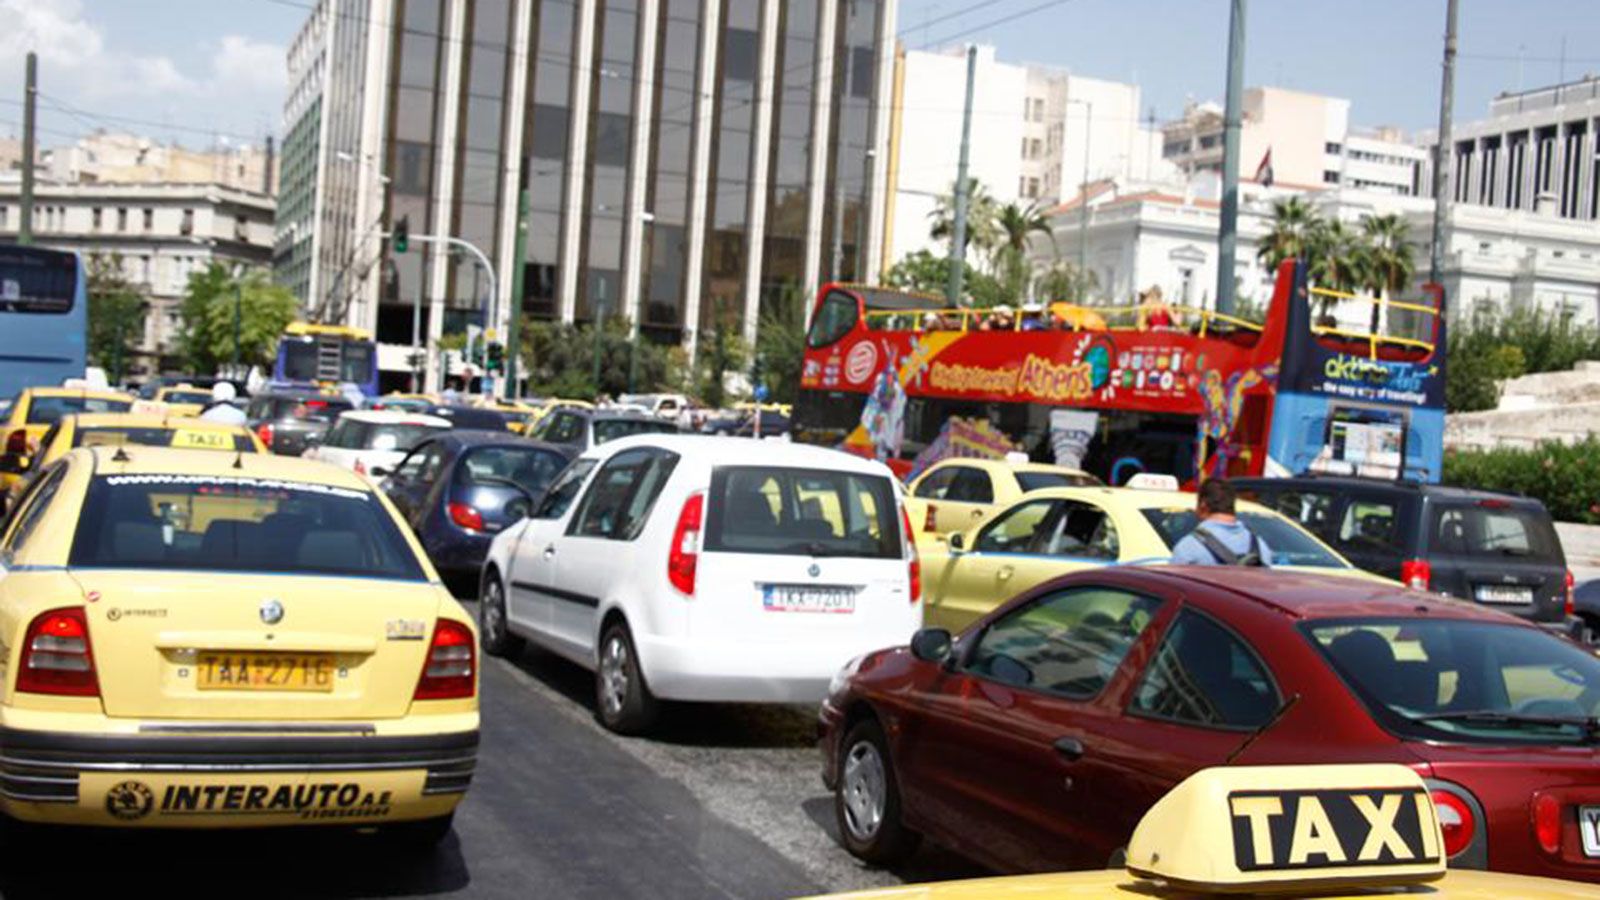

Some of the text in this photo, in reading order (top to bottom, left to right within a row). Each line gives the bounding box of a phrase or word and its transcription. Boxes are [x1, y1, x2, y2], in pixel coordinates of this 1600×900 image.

[1018, 352, 1094, 400] Athens
[1357, 386, 1375, 400] wy
[187, 433, 224, 445] TAXI
[161, 784, 361, 811] INTERAUTO
[1231, 792, 1440, 866] TAXI
